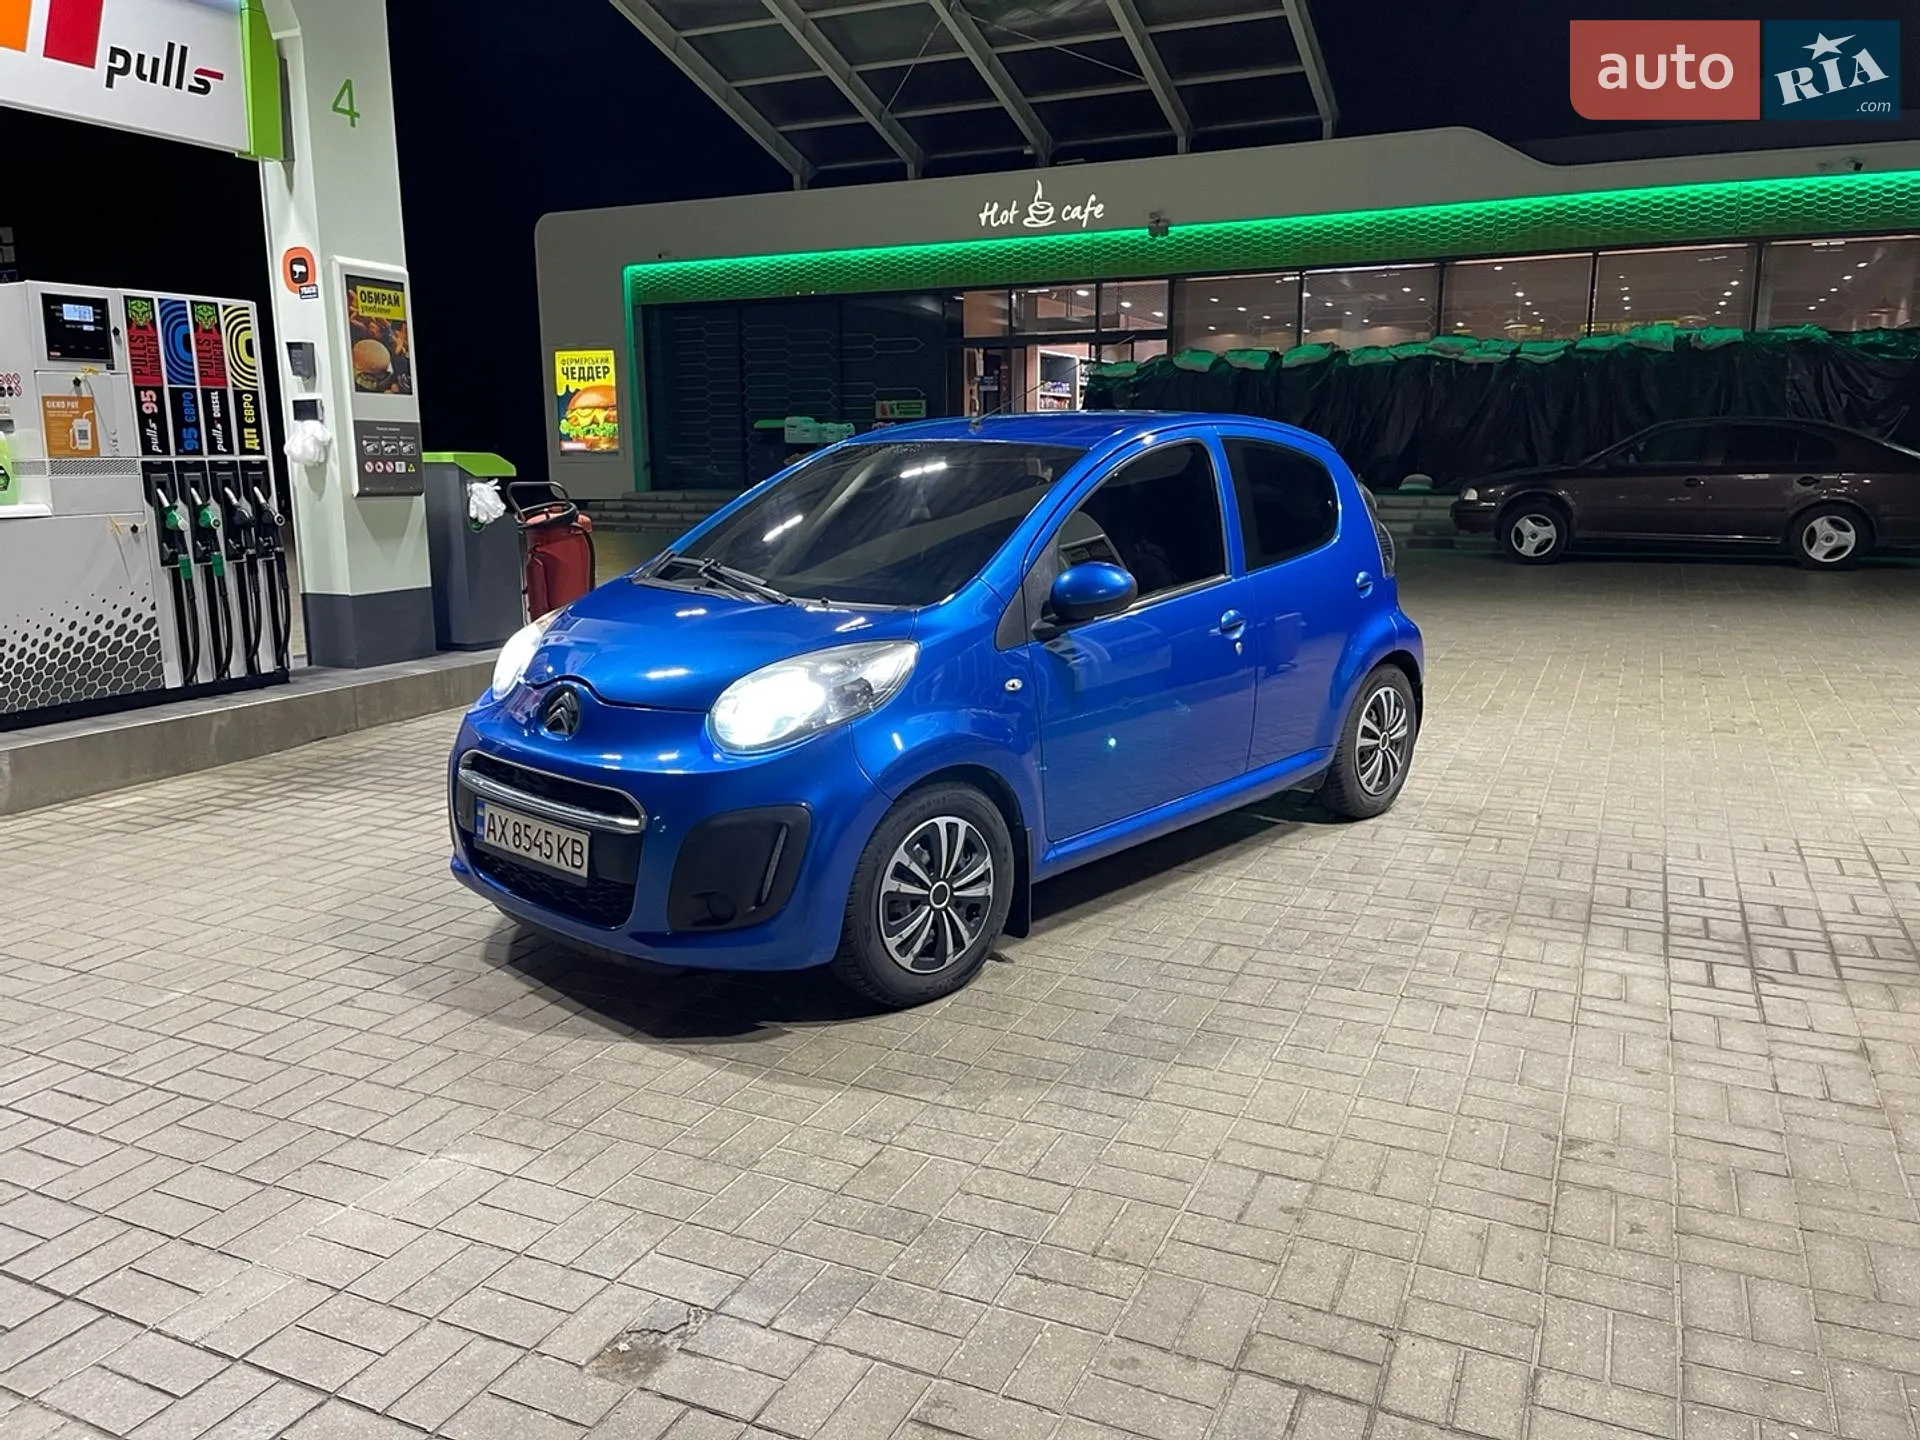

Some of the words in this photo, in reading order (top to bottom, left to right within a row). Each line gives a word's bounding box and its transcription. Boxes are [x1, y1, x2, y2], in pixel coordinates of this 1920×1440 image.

[105, 41, 224, 95] pulls
[332, 79, 360, 128] 4
[979, 200, 1019, 227] Hot
[1061, 194, 1104, 228] cafe
[359, 289, 400, 308] ОБИРАЙ
[129, 335, 147, 377] PULLS
[194, 338, 213, 377] PULLS
[561, 365, 611, 382] ЧЕДДЕР
[140, 390, 158, 414] 95
[210, 391, 221, 418] DIESEL
[146, 418, 162, 453] pulls
[182, 427, 199, 450] 95
[212, 419, 228, 452] pulls
[244, 428, 261, 450] ДП
[486, 813, 509, 846] AX
[512, 821, 554, 860] 8545
[557, 834, 584, 869] KB
